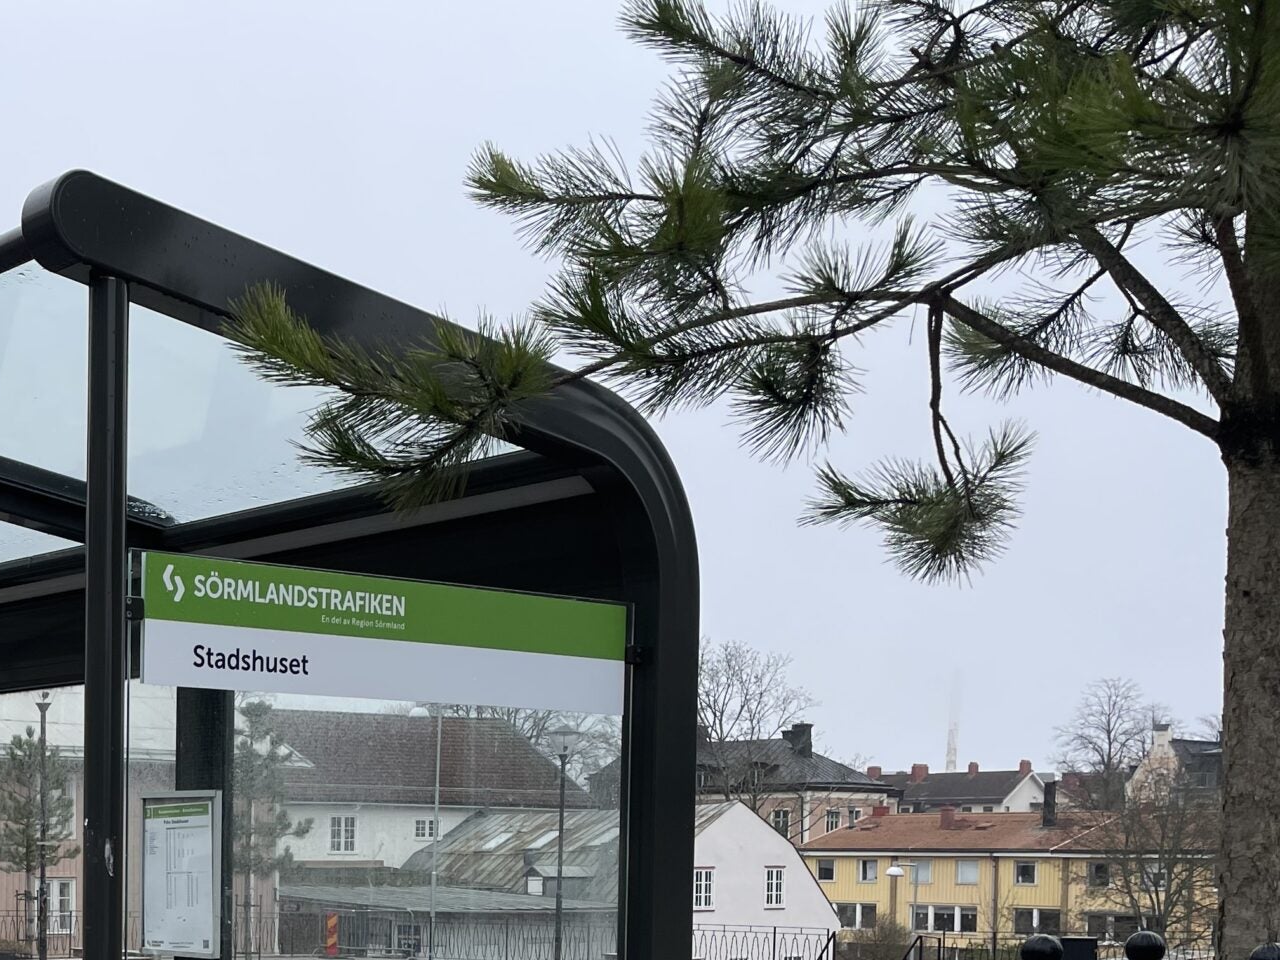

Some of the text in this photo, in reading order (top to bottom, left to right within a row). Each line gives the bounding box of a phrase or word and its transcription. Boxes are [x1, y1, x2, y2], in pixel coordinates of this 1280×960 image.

[194, 571, 405, 616] SÖRMLANDSTRAFIKEN
[321, 614, 329, 623] En
[331, 616, 341, 625] del
[352, 617, 374, 628] Region
[375, 619, 405, 630] Sörmland
[193, 644, 309, 676] Stadshuset
